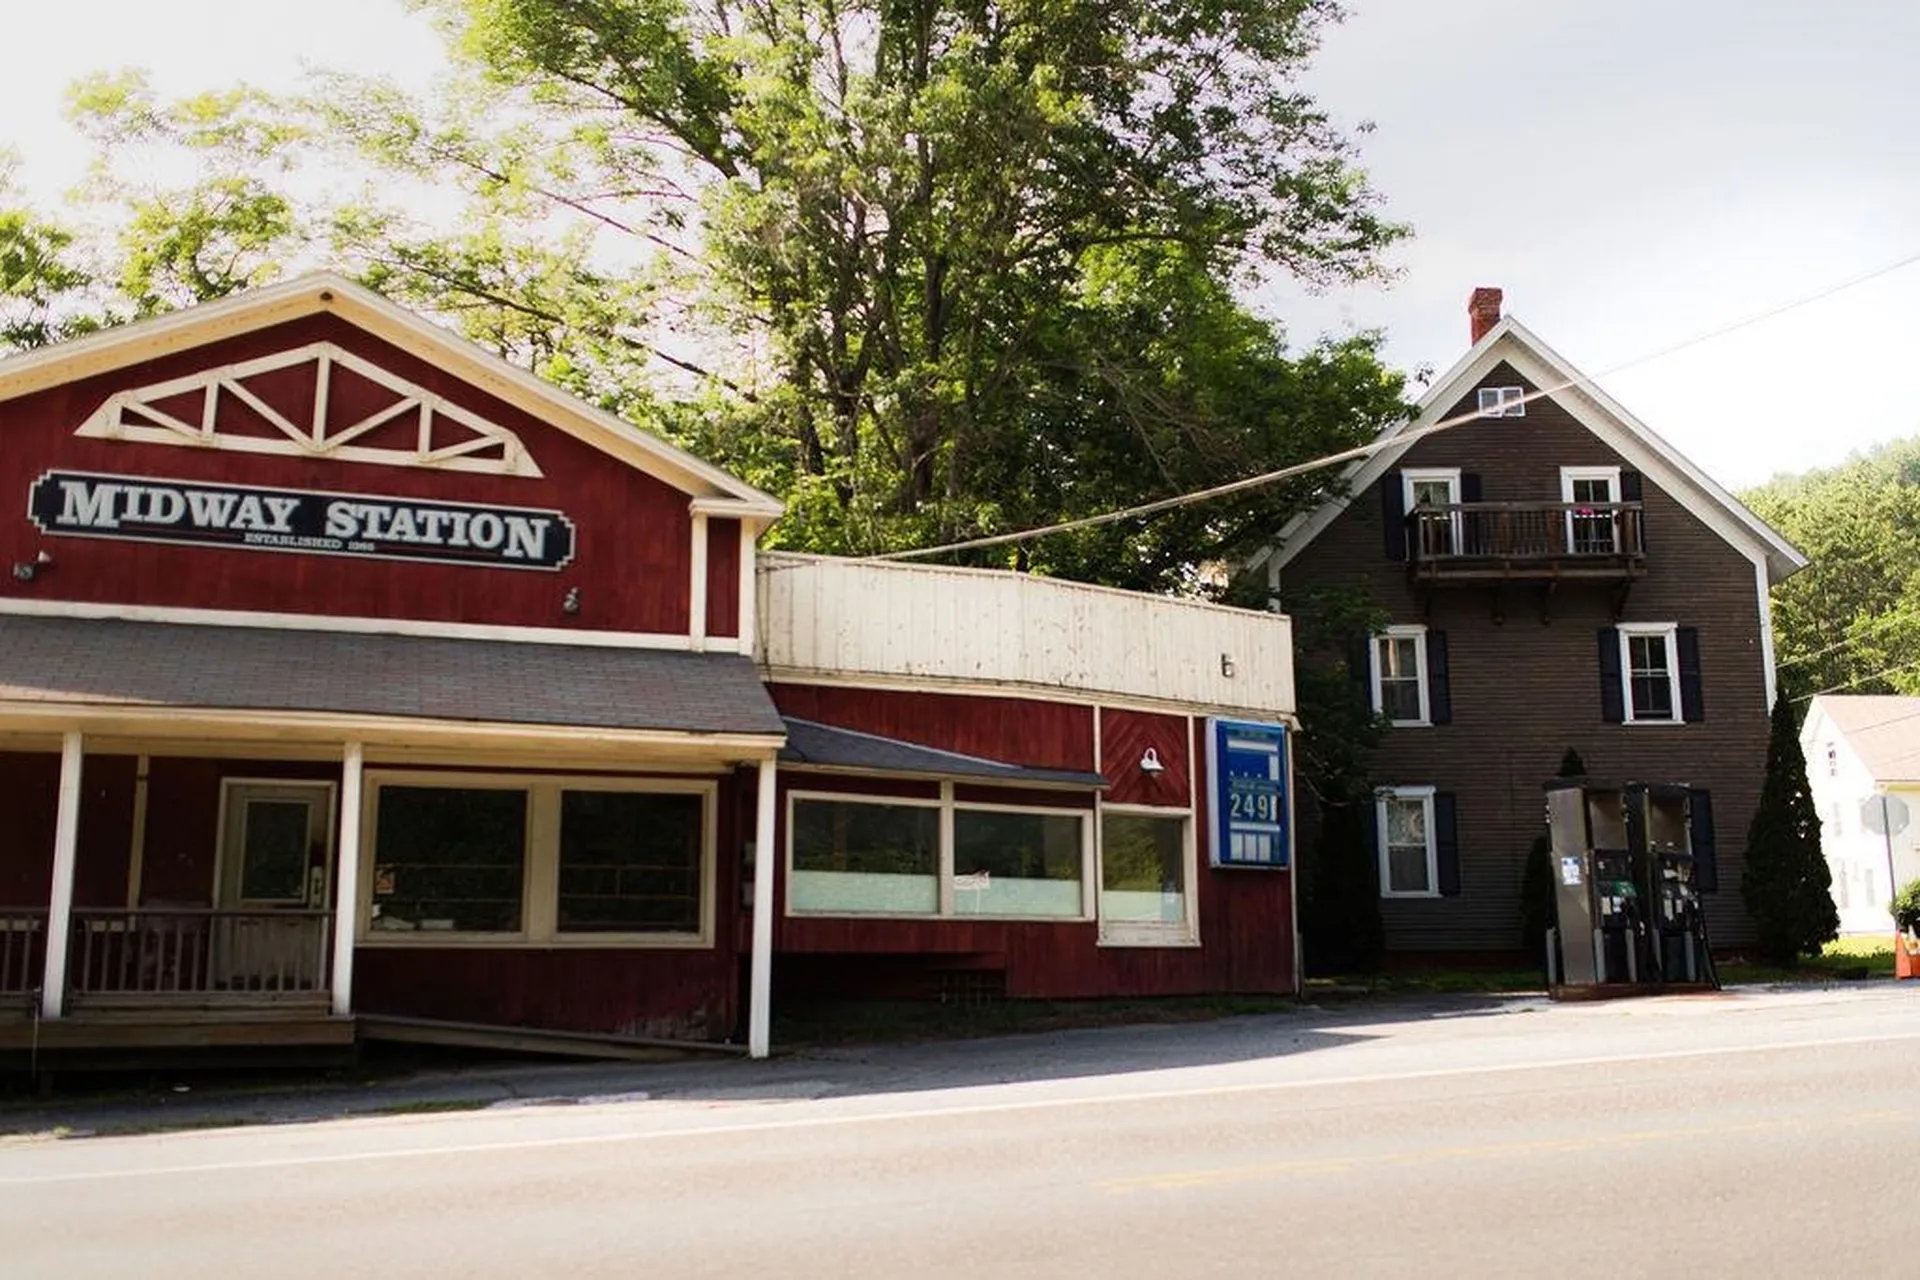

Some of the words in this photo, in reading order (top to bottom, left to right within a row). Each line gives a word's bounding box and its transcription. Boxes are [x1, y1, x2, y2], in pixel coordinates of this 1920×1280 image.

[56, 480, 301, 533] MIDWAY
[325, 501, 550, 559] STATION
[244, 532, 343, 549] ESTABLISHED
